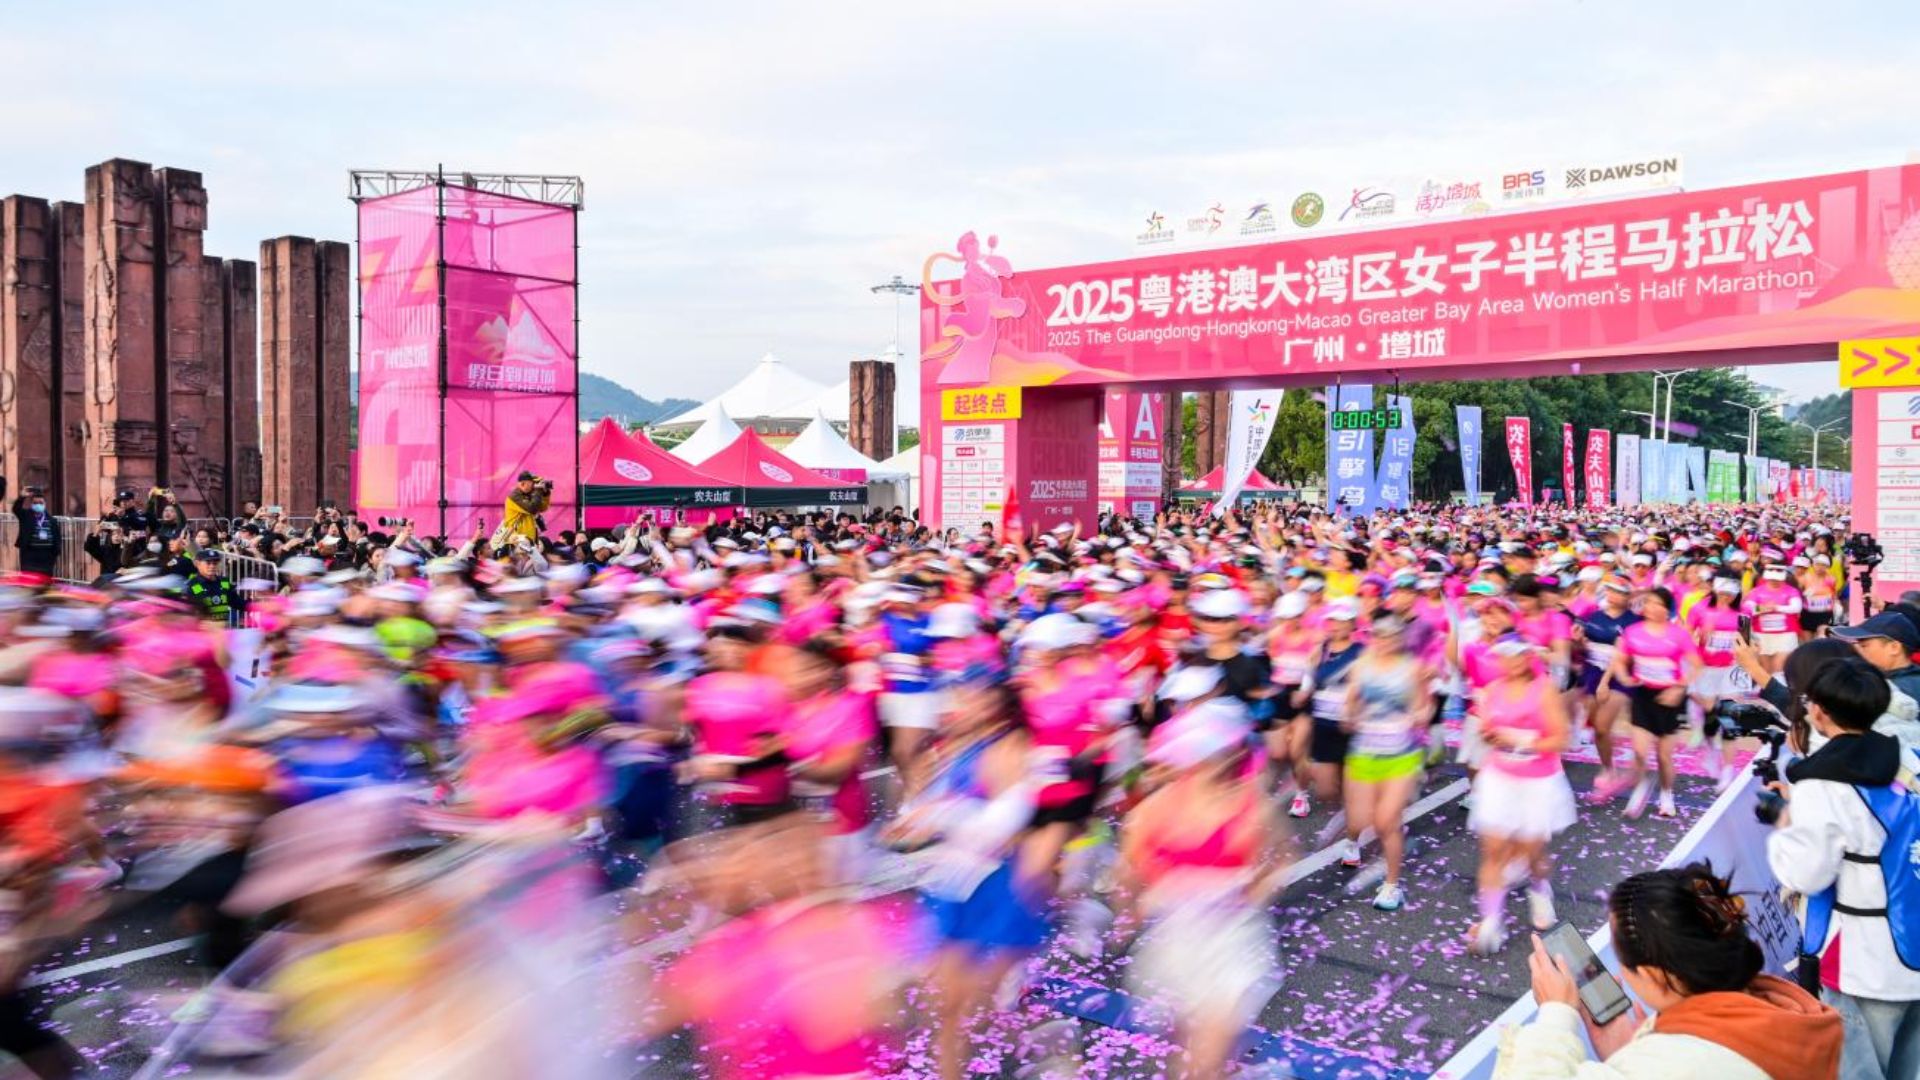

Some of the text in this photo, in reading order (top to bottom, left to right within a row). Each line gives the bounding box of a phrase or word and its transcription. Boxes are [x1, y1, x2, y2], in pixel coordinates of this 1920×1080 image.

[1589, 158, 1677, 183] DAWSON
[1046, 201, 1814, 326] 2025粤港澳大湾区女子半程马拉松
[1048, 270, 1814, 347] 2025 The Guangdong-Hongkong-Macao Greater Bay Area Women's Half Marathon
[954, 392, 1007, 415] 起终点
[1134, 392, 1156, 440] A
[1333, 411, 1400, 429] 0:00:53
[1031, 480, 1056, 499] 2025
